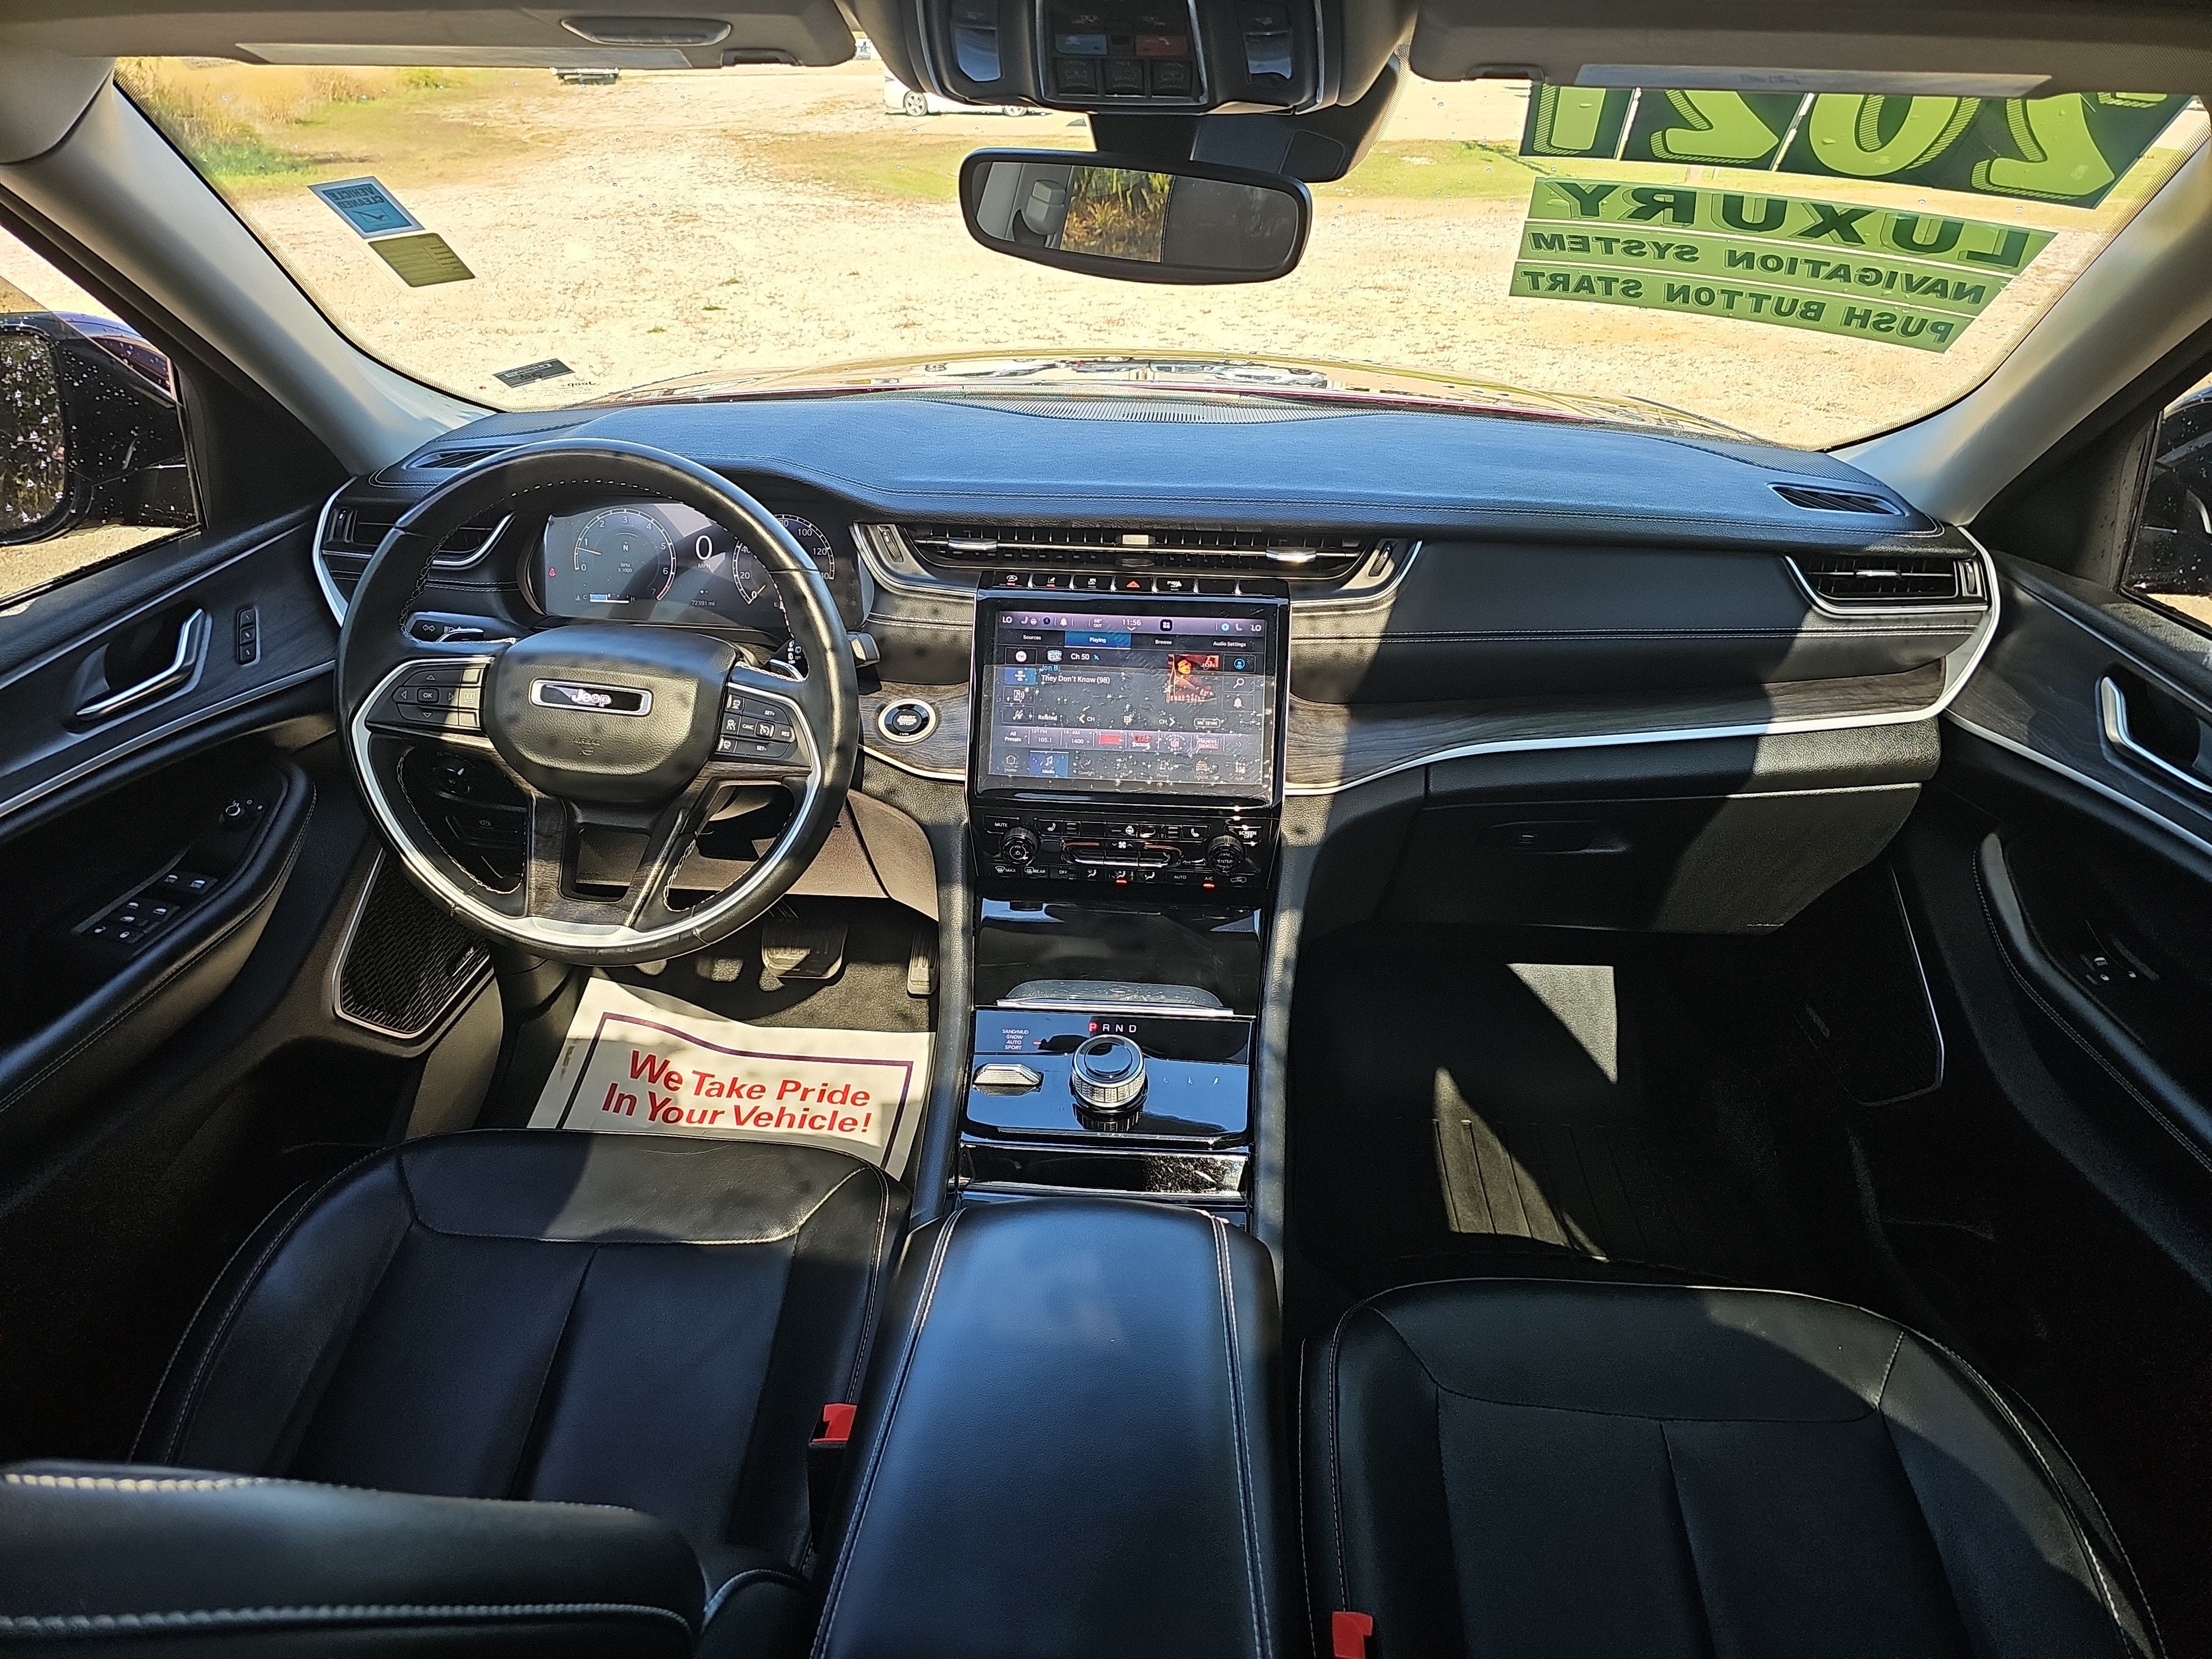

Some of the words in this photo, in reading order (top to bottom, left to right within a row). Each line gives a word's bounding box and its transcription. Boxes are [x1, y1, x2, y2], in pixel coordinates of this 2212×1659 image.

[599, 520, 605, 528] 2
[798, 528, 813, 537] 100
[584, 538, 588, 546] 1
[660, 542, 666, 550] 5
[695, 535, 713, 561] 0
[581, 563, 587, 571] 0
[740, 571, 750, 580] 20
[1041, 675, 1057, 685] They
[1058, 676, 1077, 684] Don't
[1097, 676, 1110, 684] (98)
[571, 689, 612, 707] Jeep
[1102, 1023, 1110, 1033] R
[1115, 1024, 1123, 1033] N
[1128, 1024, 1137, 1033] D
[628, 1049, 684, 1092] We
[690, 1069, 766, 1101] Take
[775, 1078, 871, 1107] Pride
[601, 1082, 637, 1117] In
[646, 1089, 725, 1125] Your
[733, 1104, 872, 1134] Vehicle!
